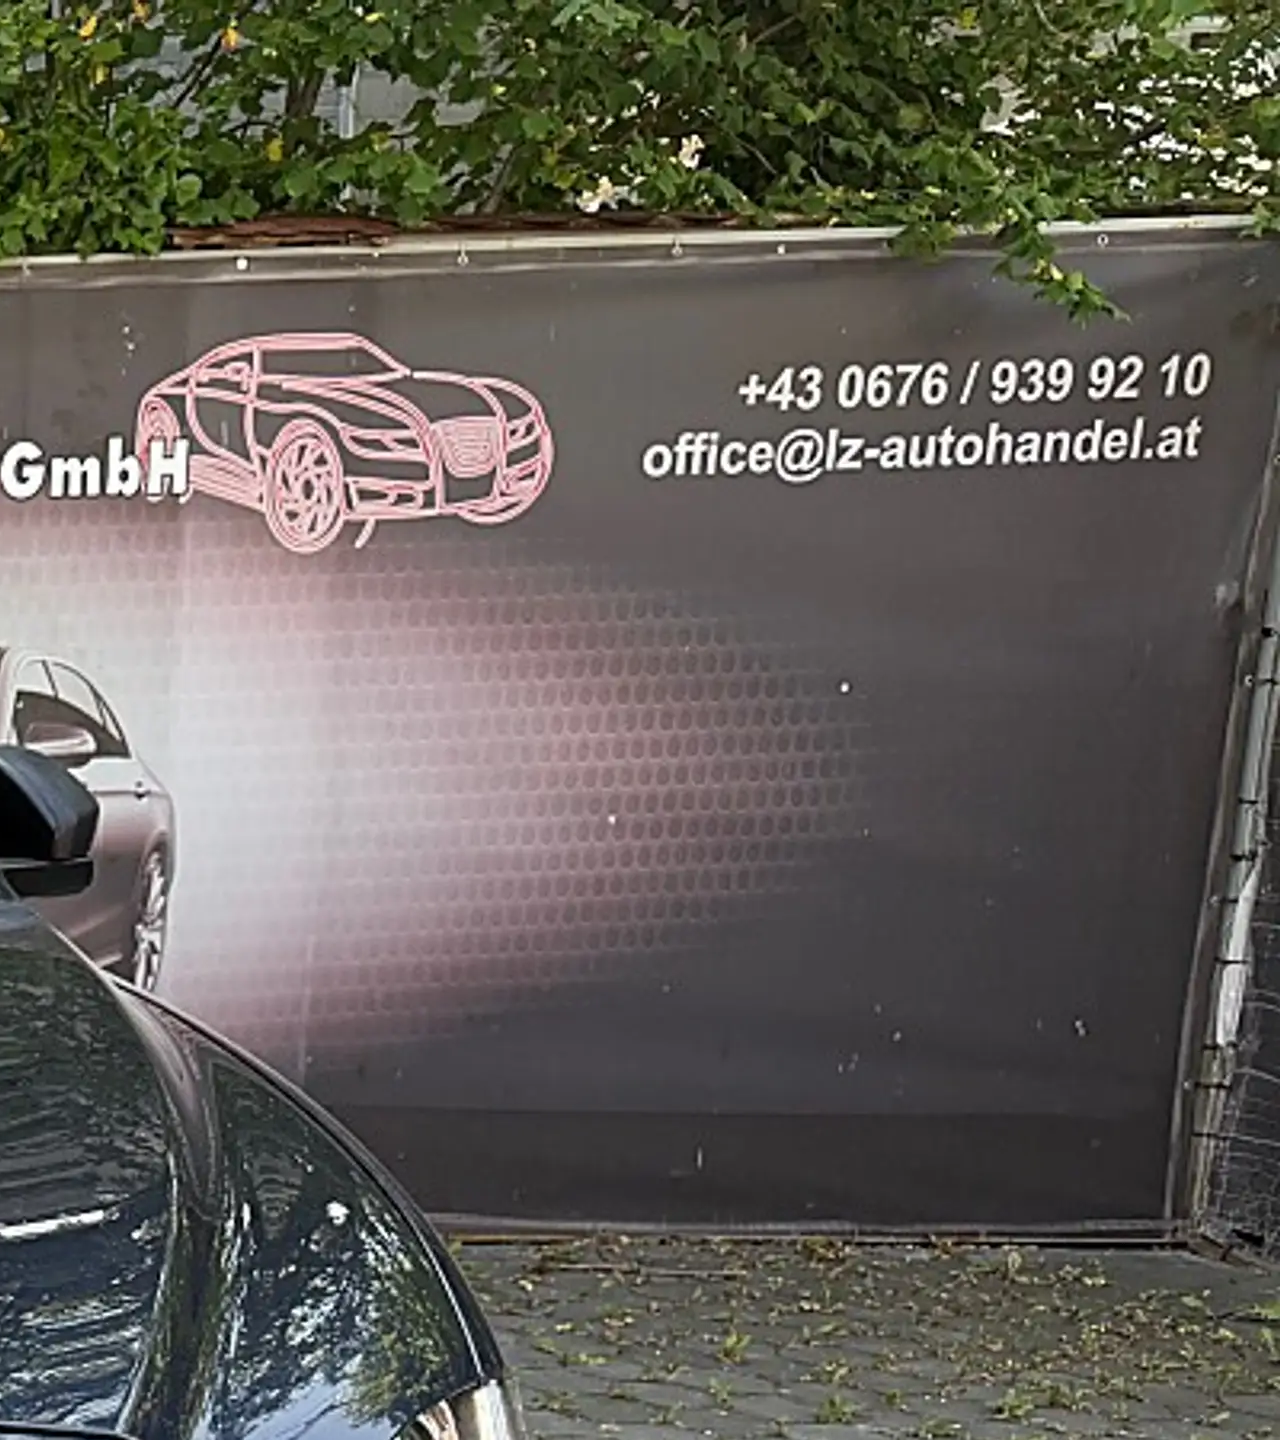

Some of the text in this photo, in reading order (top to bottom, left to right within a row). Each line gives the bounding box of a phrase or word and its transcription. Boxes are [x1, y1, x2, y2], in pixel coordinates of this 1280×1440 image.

[738, 352, 1212, 411] +43 0676 / 939 92 10
[0, 436, 191, 500] GmbH
[642, 415, 1203, 483] office@lz-autohandel.at
